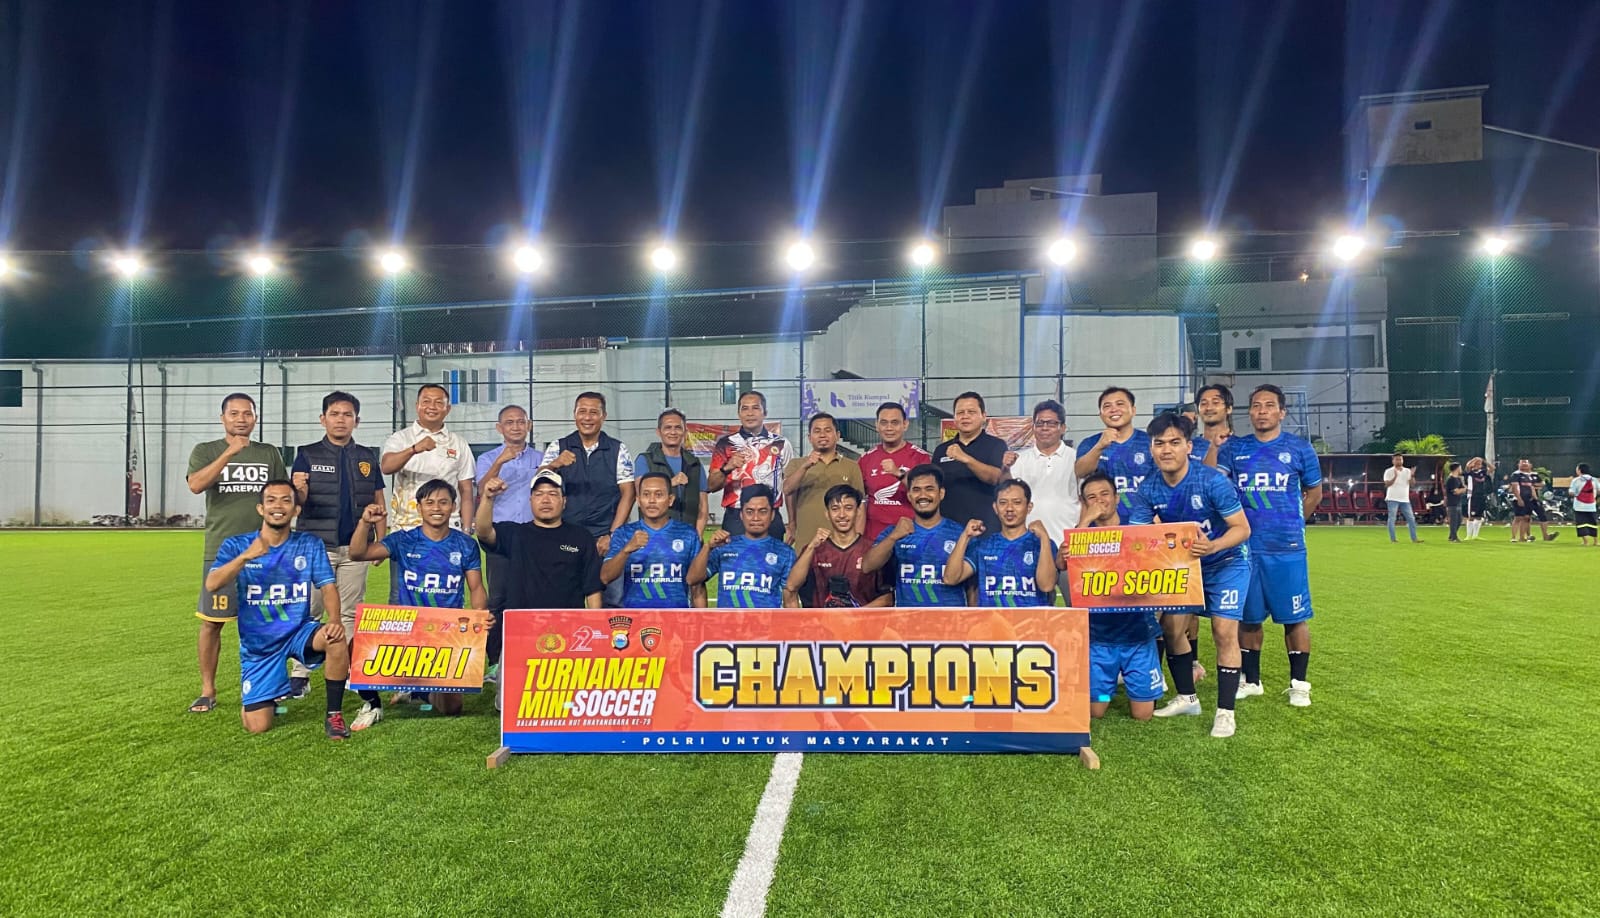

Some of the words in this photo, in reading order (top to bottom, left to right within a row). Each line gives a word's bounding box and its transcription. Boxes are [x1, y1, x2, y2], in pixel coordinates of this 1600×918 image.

[220, 466, 268, 482] 1405
[1115, 476, 1145, 488] AM
[1238, 472, 1290, 487] PAM
[1069, 530, 1124, 545] TURNAMEN
[1069, 544, 1088, 556] MINI
[1088, 542, 1120, 554] SOCCER
[631, 563, 682, 578] PAM
[901, 564, 947, 579] PA
[404, 570, 461, 588] PAM
[723, 572, 772, 589] PAM
[986, 576, 1036, 592] PAM
[1082, 570, 1118, 596] TOP
[1123, 568, 1190, 595] SCORE
[246, 582, 308, 600] PAM
[1220, 590, 1238, 604] 20
[212, 594, 228, 610] 19
[361, 608, 418, 622] TURNAMEN
[358, 620, 380, 632] MINI
[380, 621, 414, 632] SOCCER
[362, 644, 453, 678] JUARA
[524, 656, 666, 690] TURNAMEN
[695, 642, 1056, 710] CHAMPIONS
[517, 690, 574, 718] MINI
[572, 689, 656, 718] SOCCER
[642, 737, 705, 745] POLRI
[722, 736, 791, 746] UNTUK
[807, 736, 950, 746] MASYARAKAT
